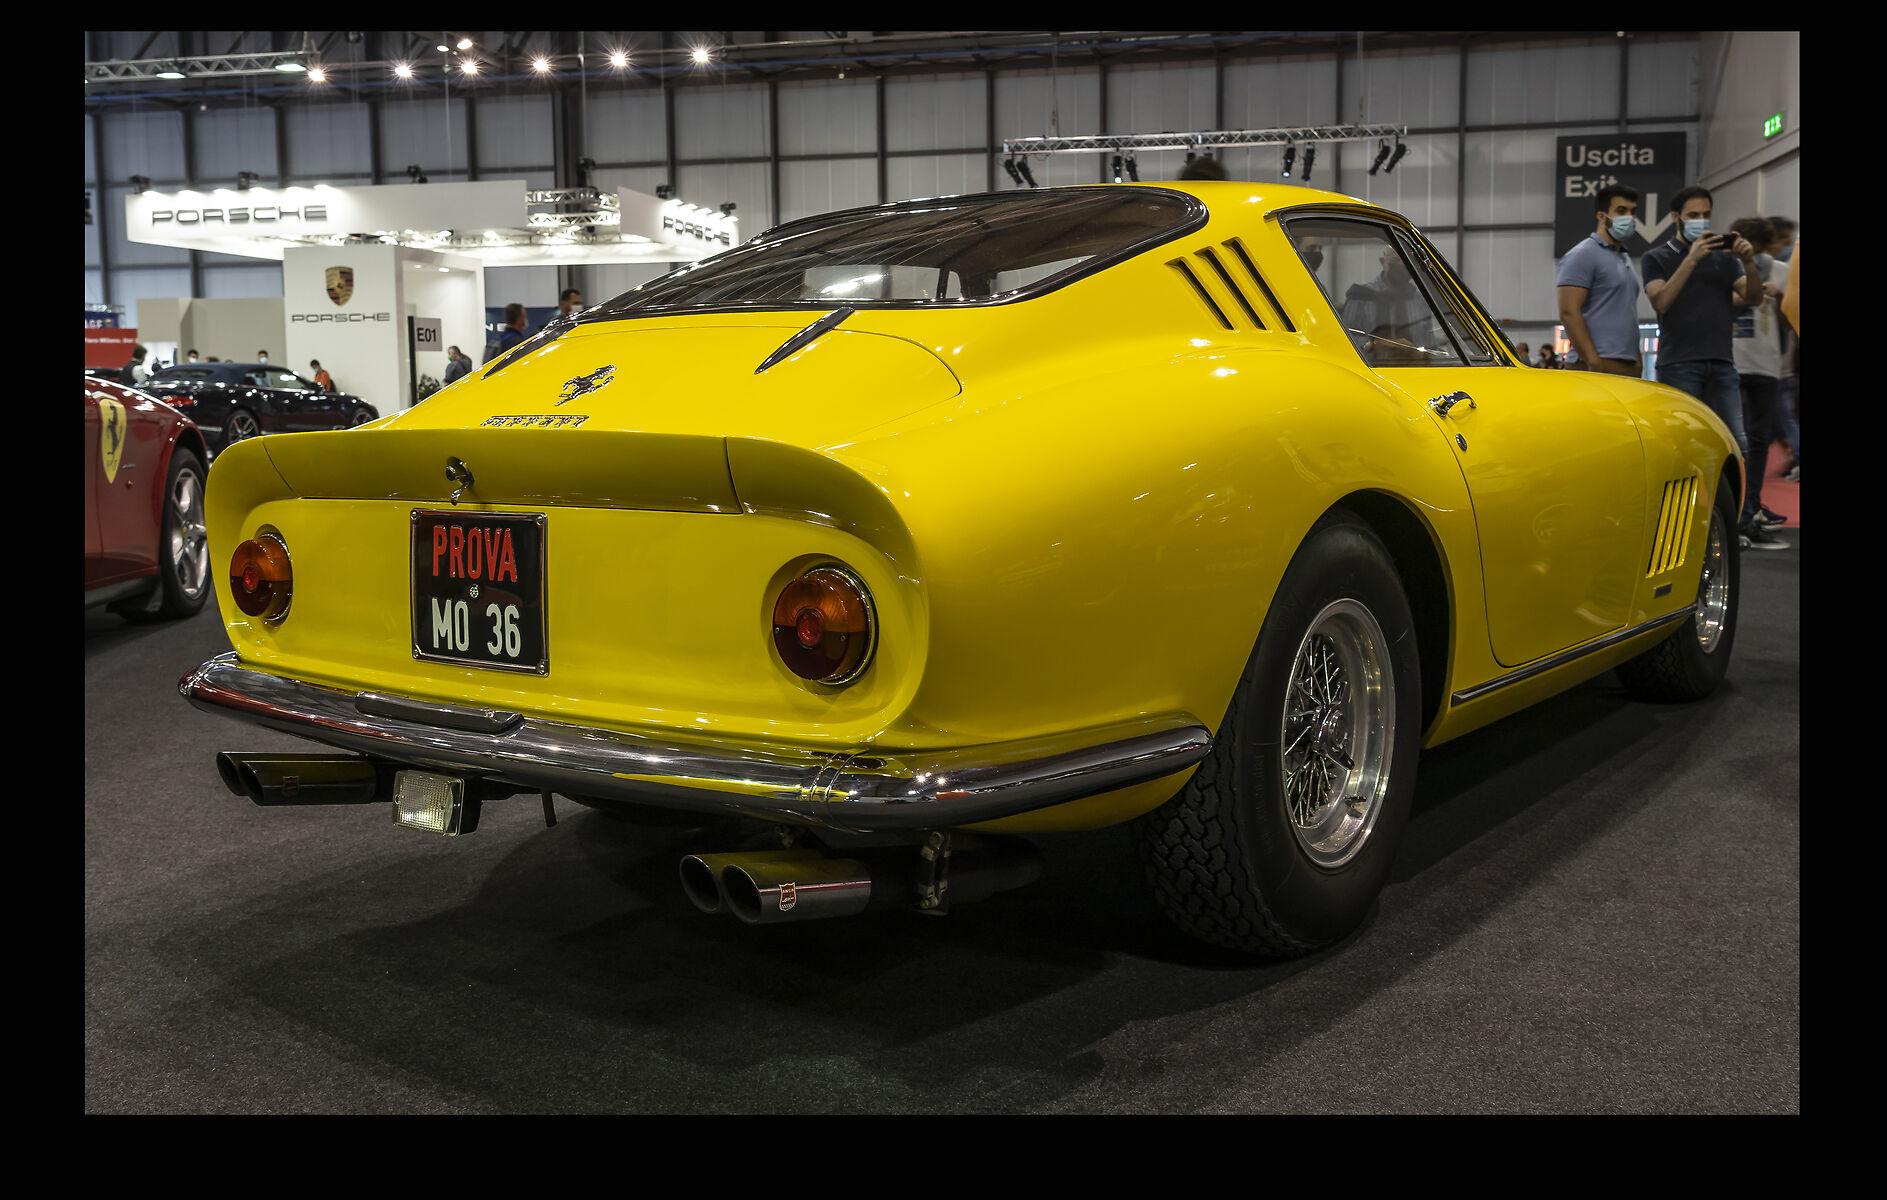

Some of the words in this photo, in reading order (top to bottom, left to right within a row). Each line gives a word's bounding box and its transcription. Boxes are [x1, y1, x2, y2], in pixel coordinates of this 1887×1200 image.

[1565, 143, 1654, 168] Uscita
[152, 205, 328, 225] PORSCHE
[663, 215, 730, 246] PORSCHE
[291, 312, 391, 323] PORSCHE
[416, 327, 437, 343] E01
[432, 525, 518, 583] PROVA
[431, 597, 470, 652] MO
[486, 603, 521, 658] 36
